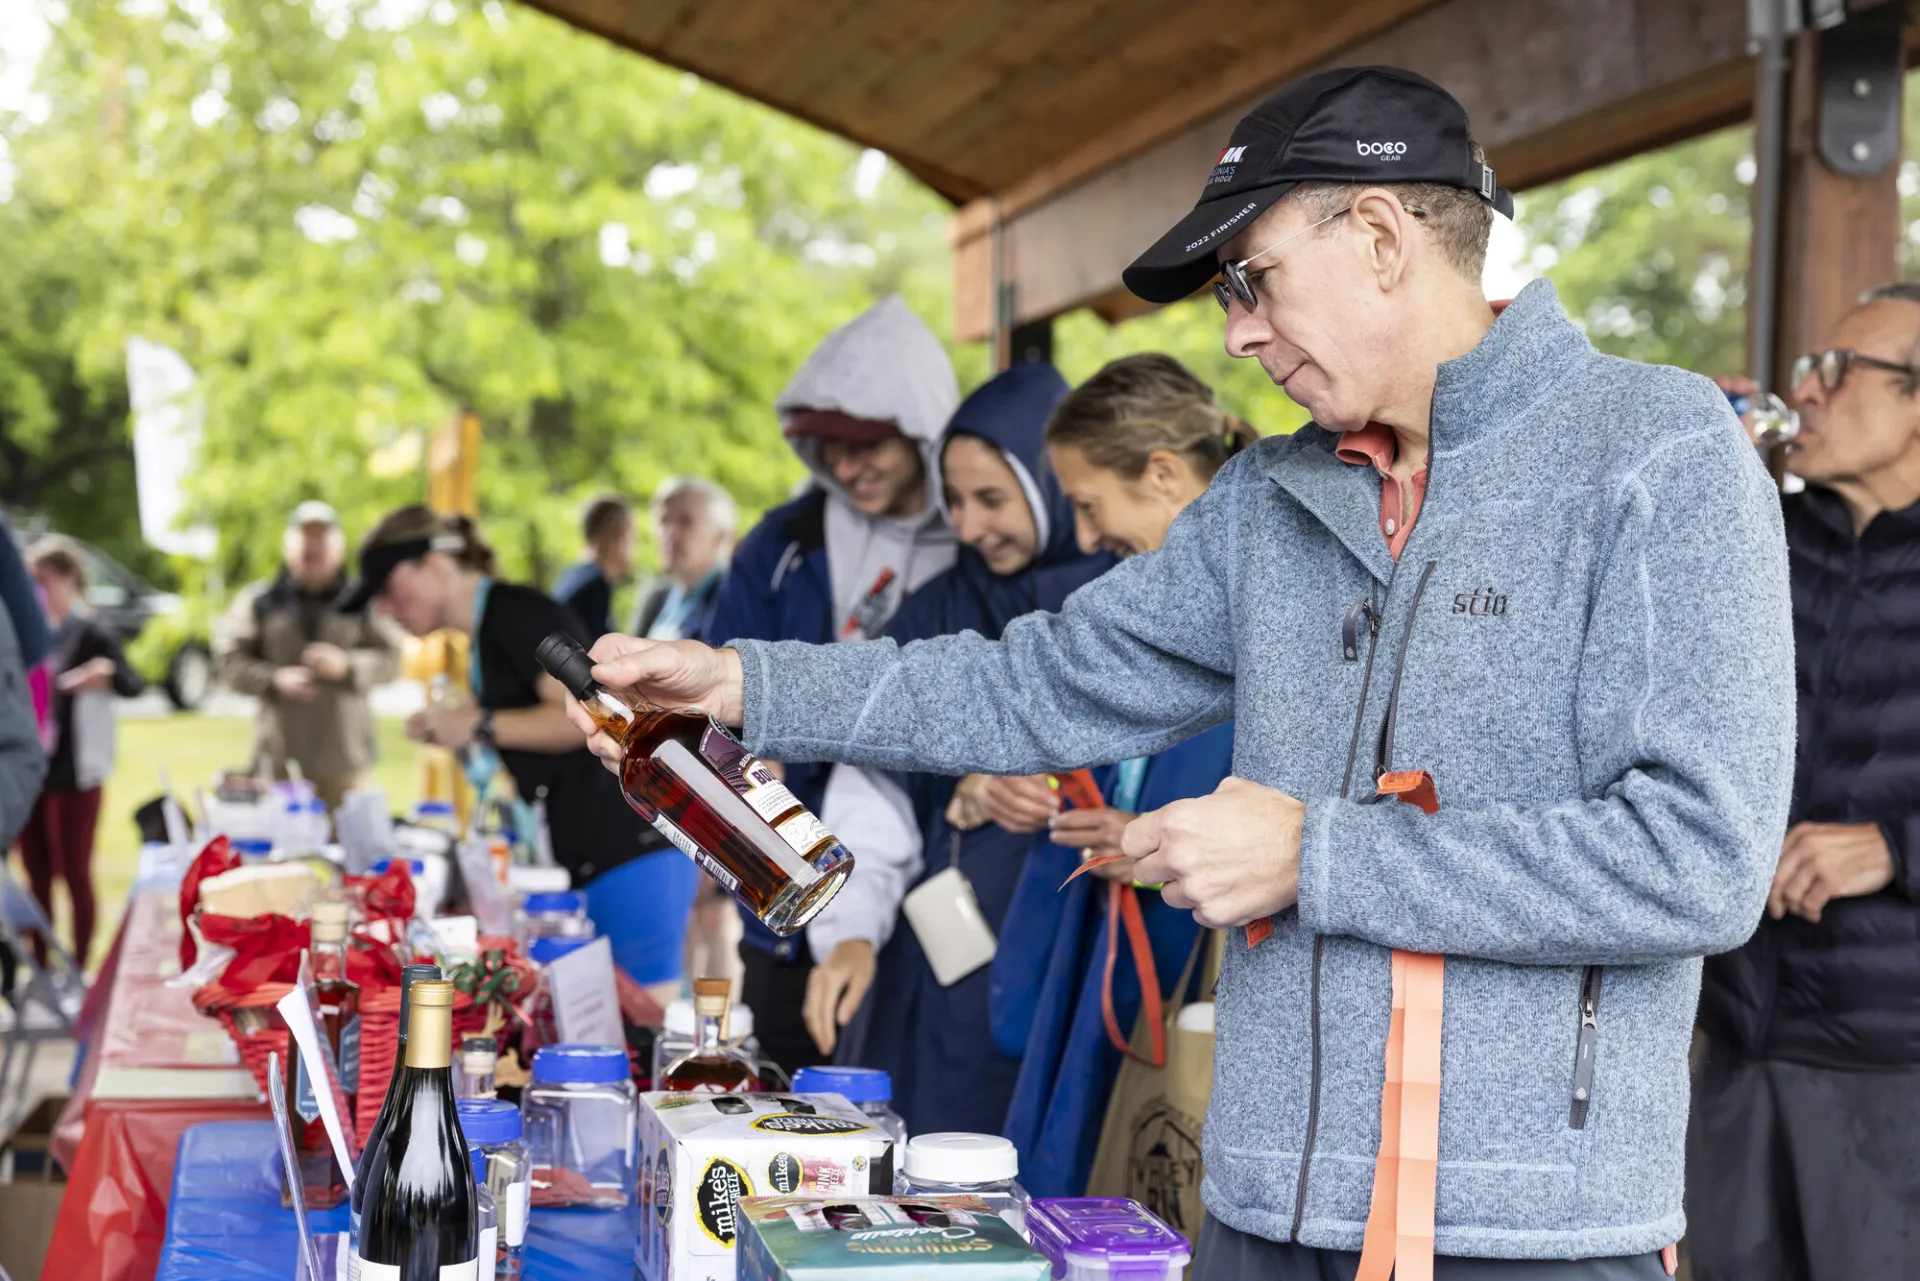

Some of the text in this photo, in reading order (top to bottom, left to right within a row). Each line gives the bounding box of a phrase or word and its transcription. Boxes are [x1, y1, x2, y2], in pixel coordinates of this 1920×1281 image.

[1356, 139, 1407, 156] boco
[1185, 202, 1257, 252] 2022 FINISHER
[1452, 587, 1508, 616] stio
[777, 1152, 790, 1192] mike's
[816, 1166, 831, 1192] PINK
[709, 1165, 736, 1236] mike's
